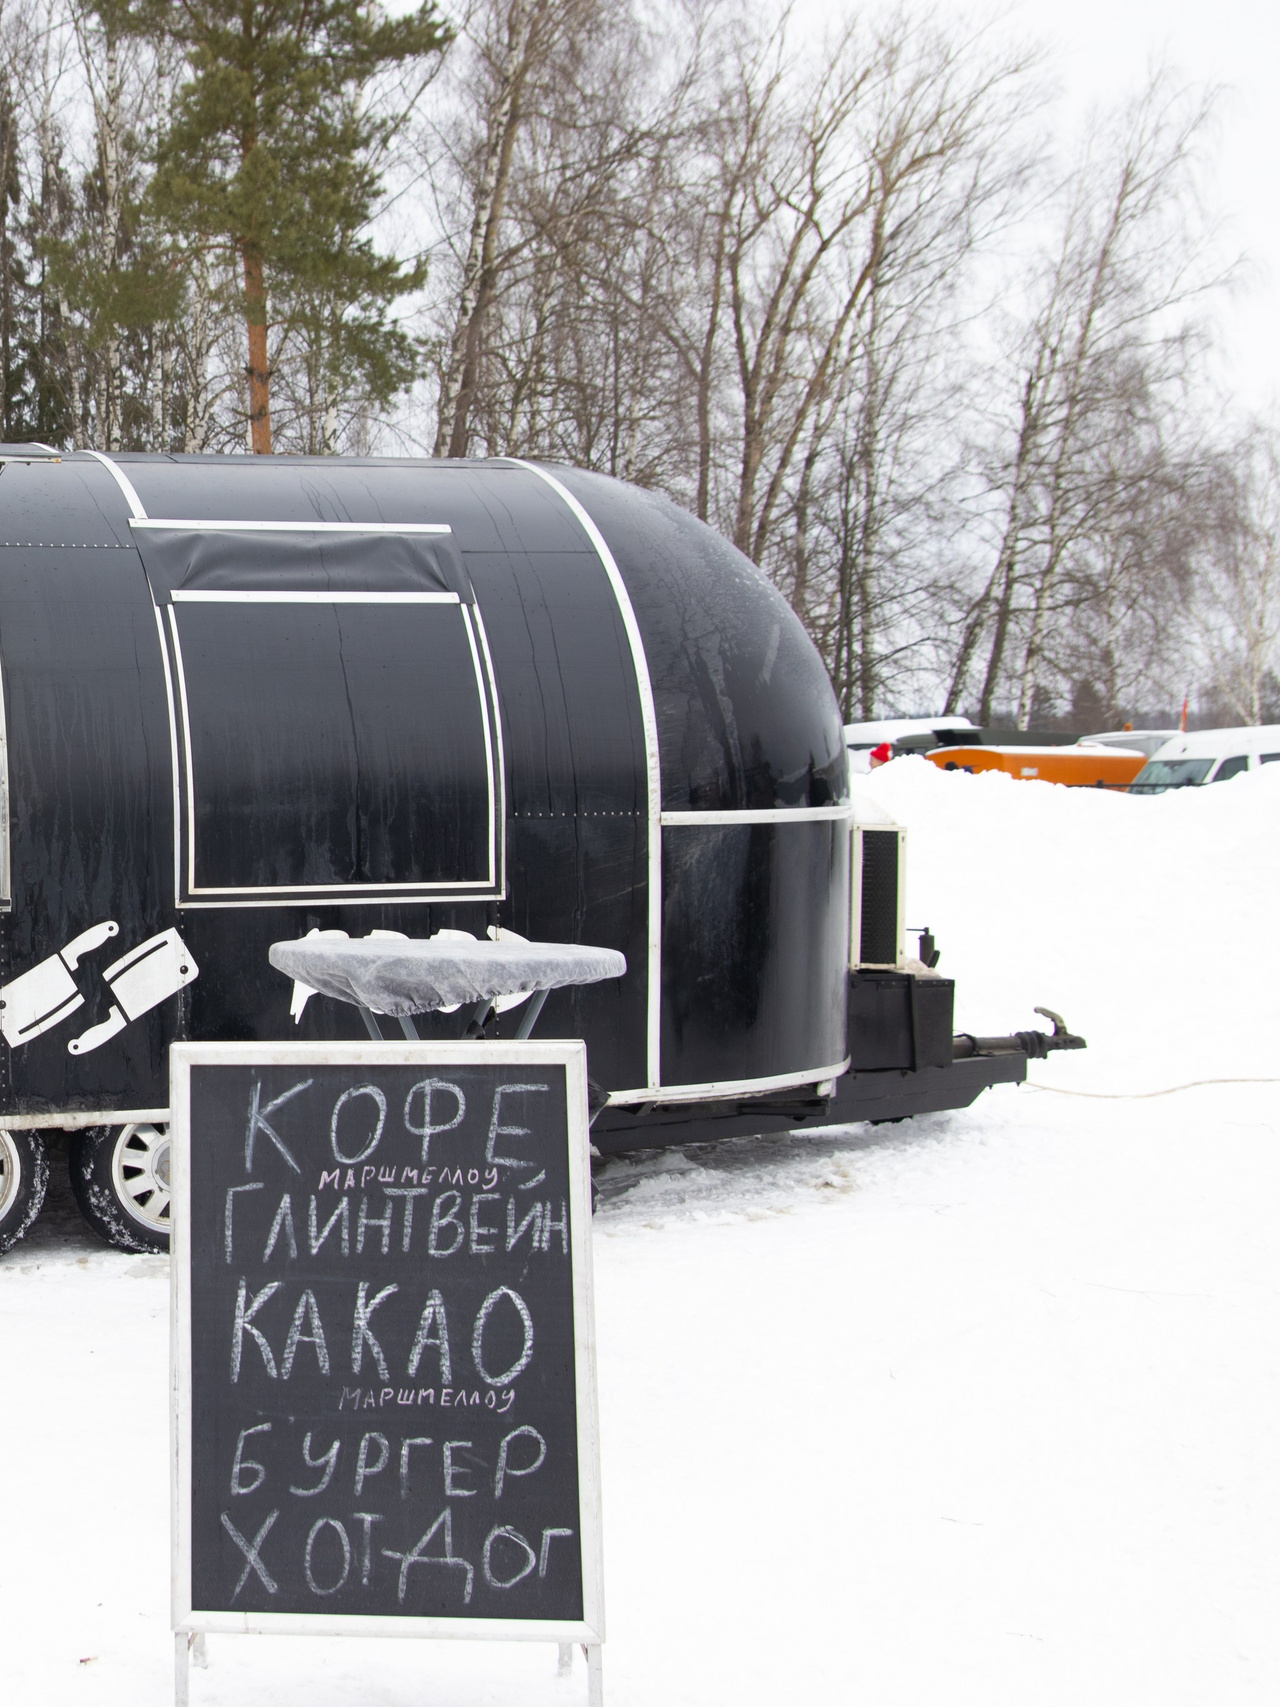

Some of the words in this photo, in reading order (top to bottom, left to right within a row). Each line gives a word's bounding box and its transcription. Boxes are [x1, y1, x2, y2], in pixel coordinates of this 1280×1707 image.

[242, 1076, 551, 1175] КОФЕ
[222, 1168, 569, 1264] ГЛИНТВЕЙН
[317, 1163, 499, 1192] МАРШМЕЛЛОУ
[229, 1275, 535, 1388] КАКАО
[337, 1386, 517, 1414] МАРШМЕЛЛОУ
[229, 1423, 548, 1500] БУРГЕР
